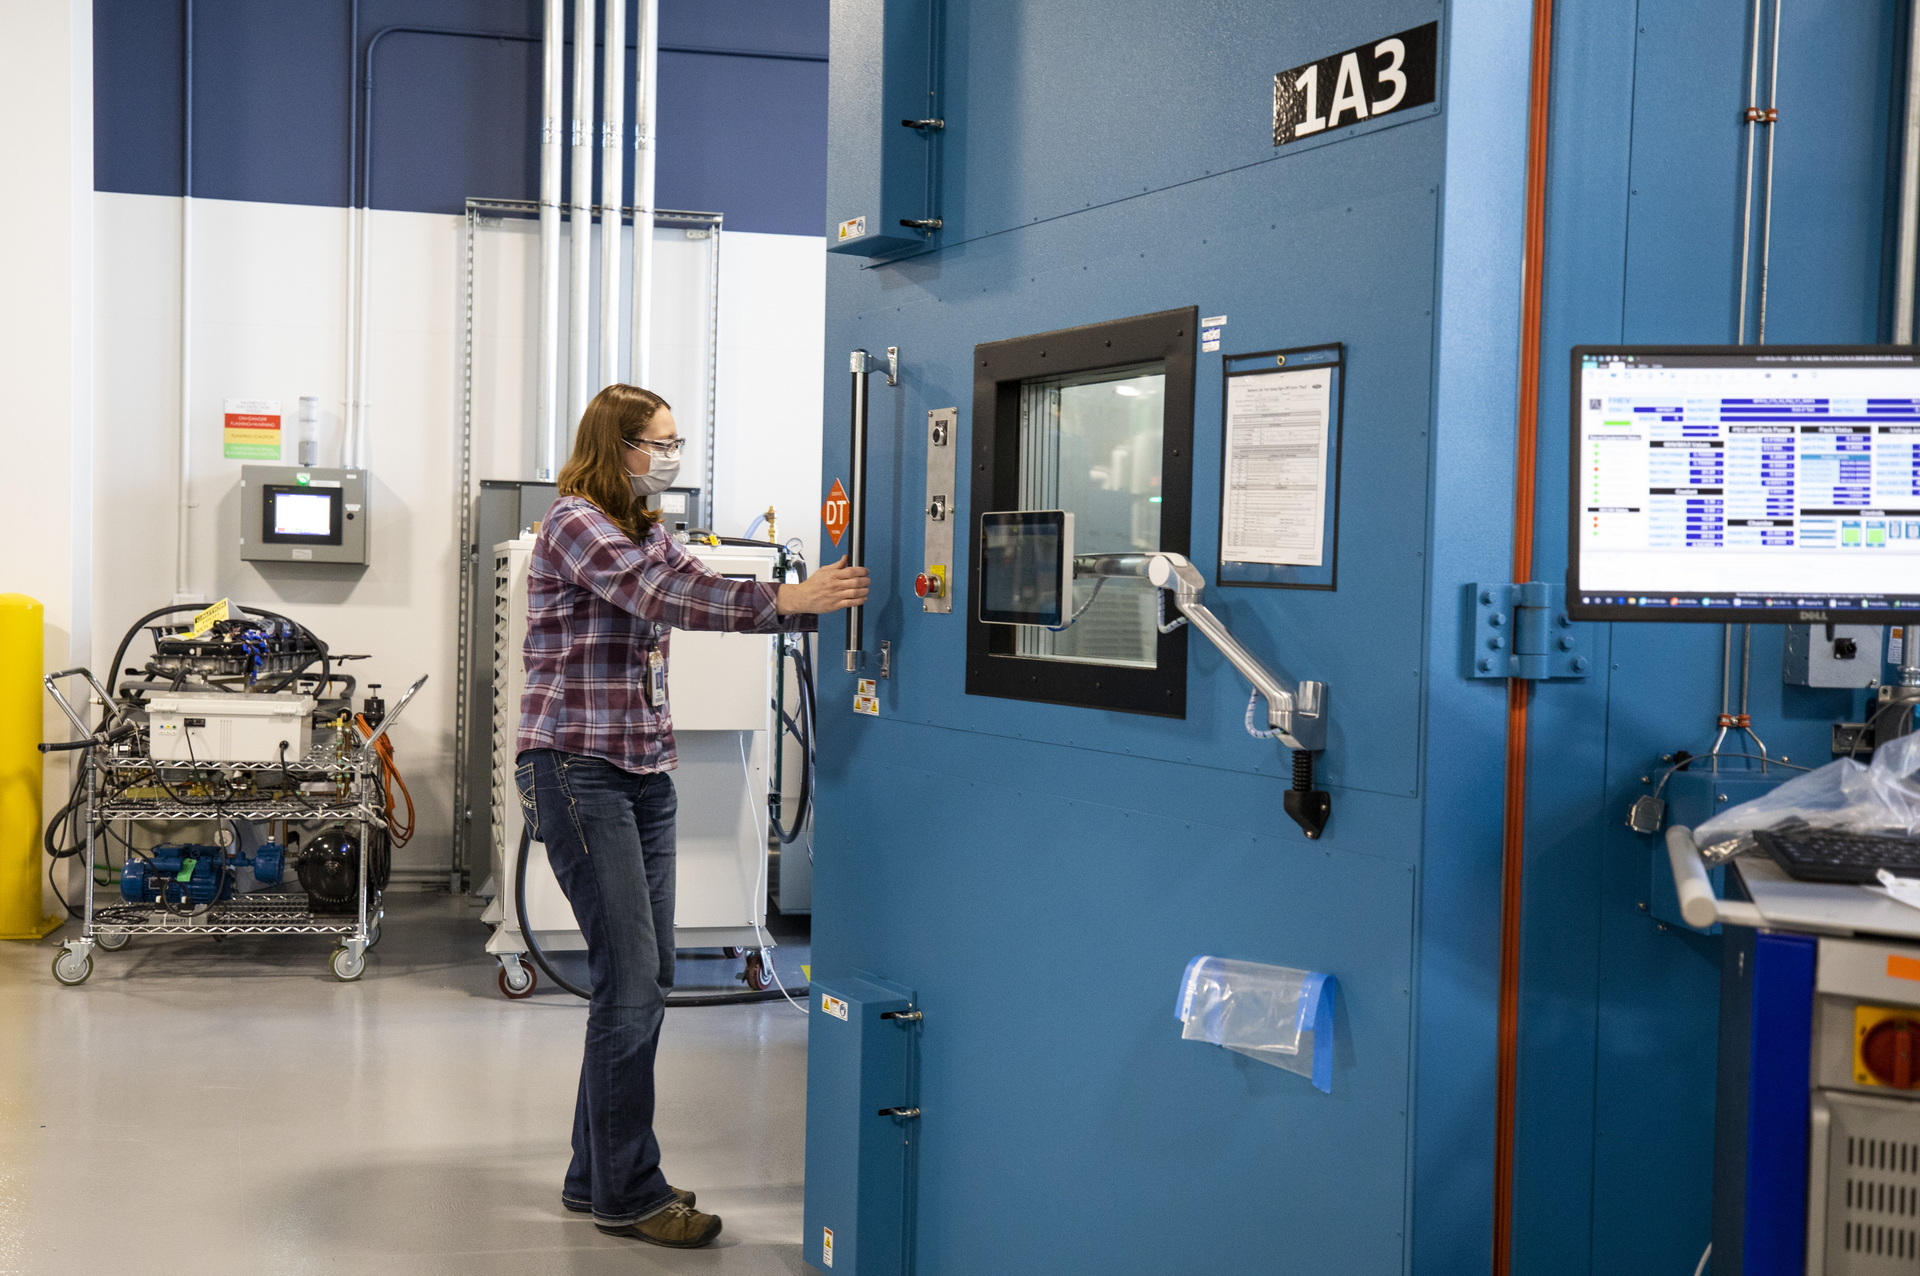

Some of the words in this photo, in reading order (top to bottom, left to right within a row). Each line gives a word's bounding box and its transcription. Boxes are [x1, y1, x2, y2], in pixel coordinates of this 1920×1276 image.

[1294, 37, 1408, 137] 1A3
[826, 500, 847, 525] DT
[1800, 611, 1828, 621] DELL
